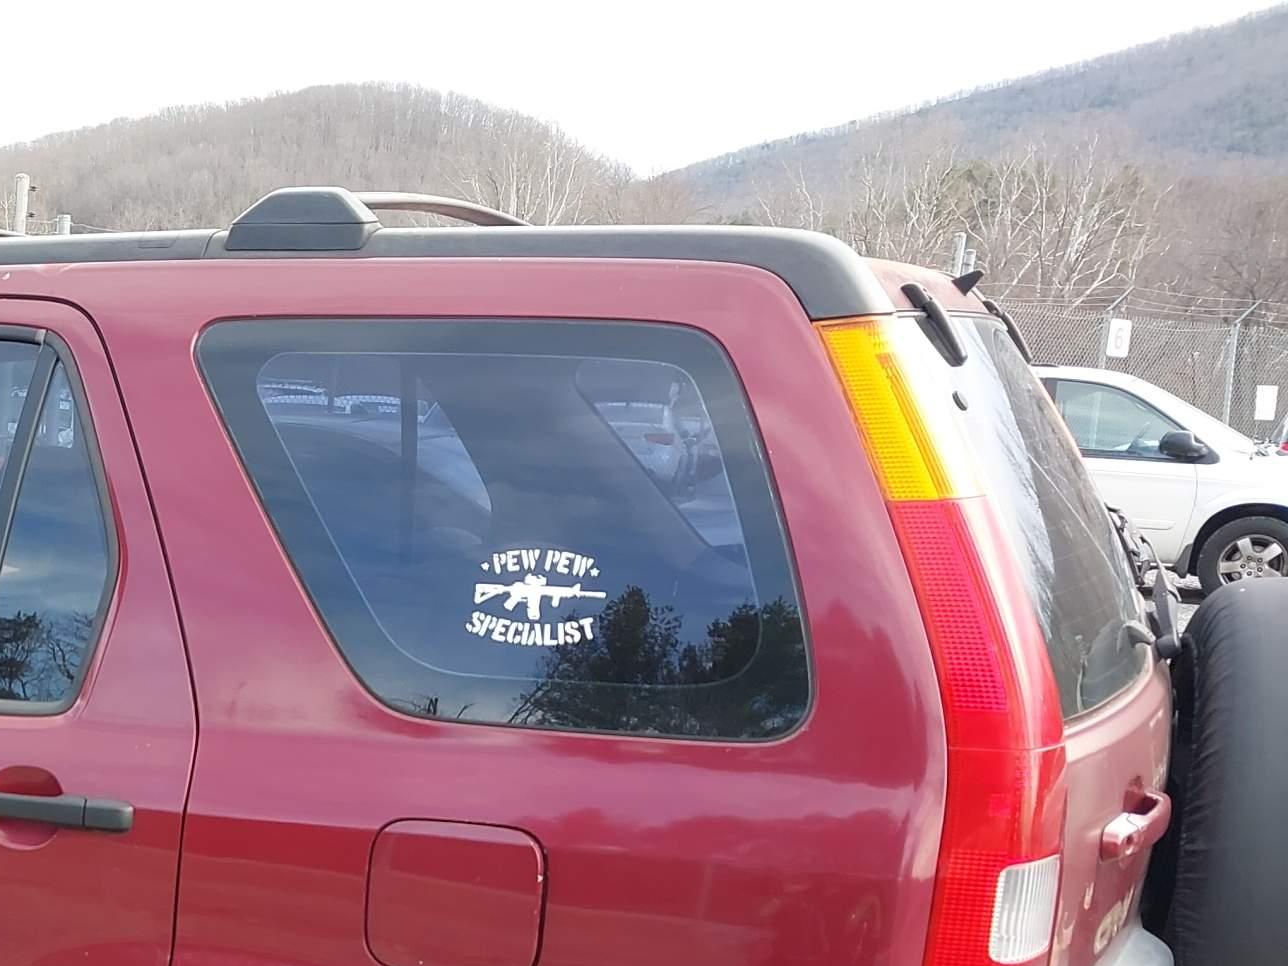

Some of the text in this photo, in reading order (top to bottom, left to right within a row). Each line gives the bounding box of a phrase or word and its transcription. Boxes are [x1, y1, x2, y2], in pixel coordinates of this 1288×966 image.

[1114, 327, 1124, 350] 6
[493, 549, 595, 578] PEW PEW
[466, 611, 594, 646] SPECIALIST
